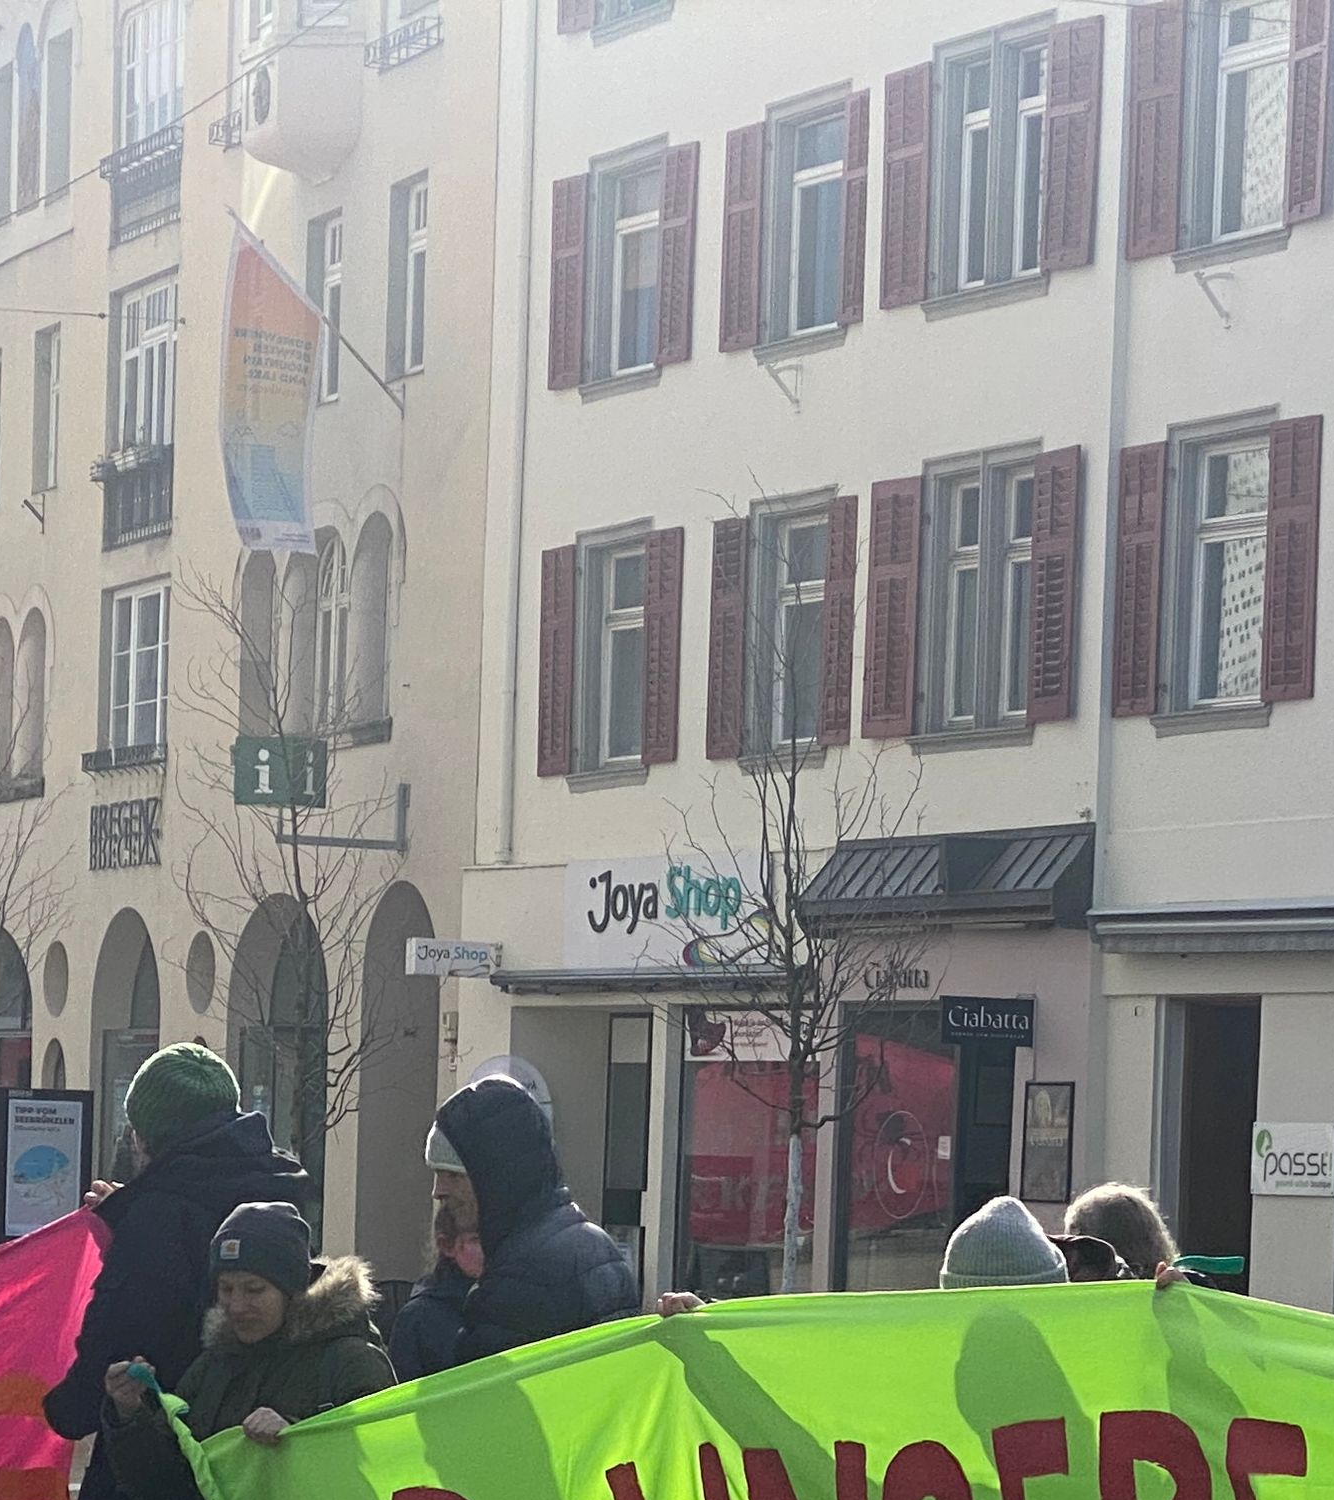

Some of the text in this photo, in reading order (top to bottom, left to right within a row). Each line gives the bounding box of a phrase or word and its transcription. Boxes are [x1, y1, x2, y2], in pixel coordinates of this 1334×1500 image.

[587, 865, 742, 935] Joya Shop
[417, 945, 489, 963] Joya Shop
[947, 1005, 1030, 1031] Ciabatta
